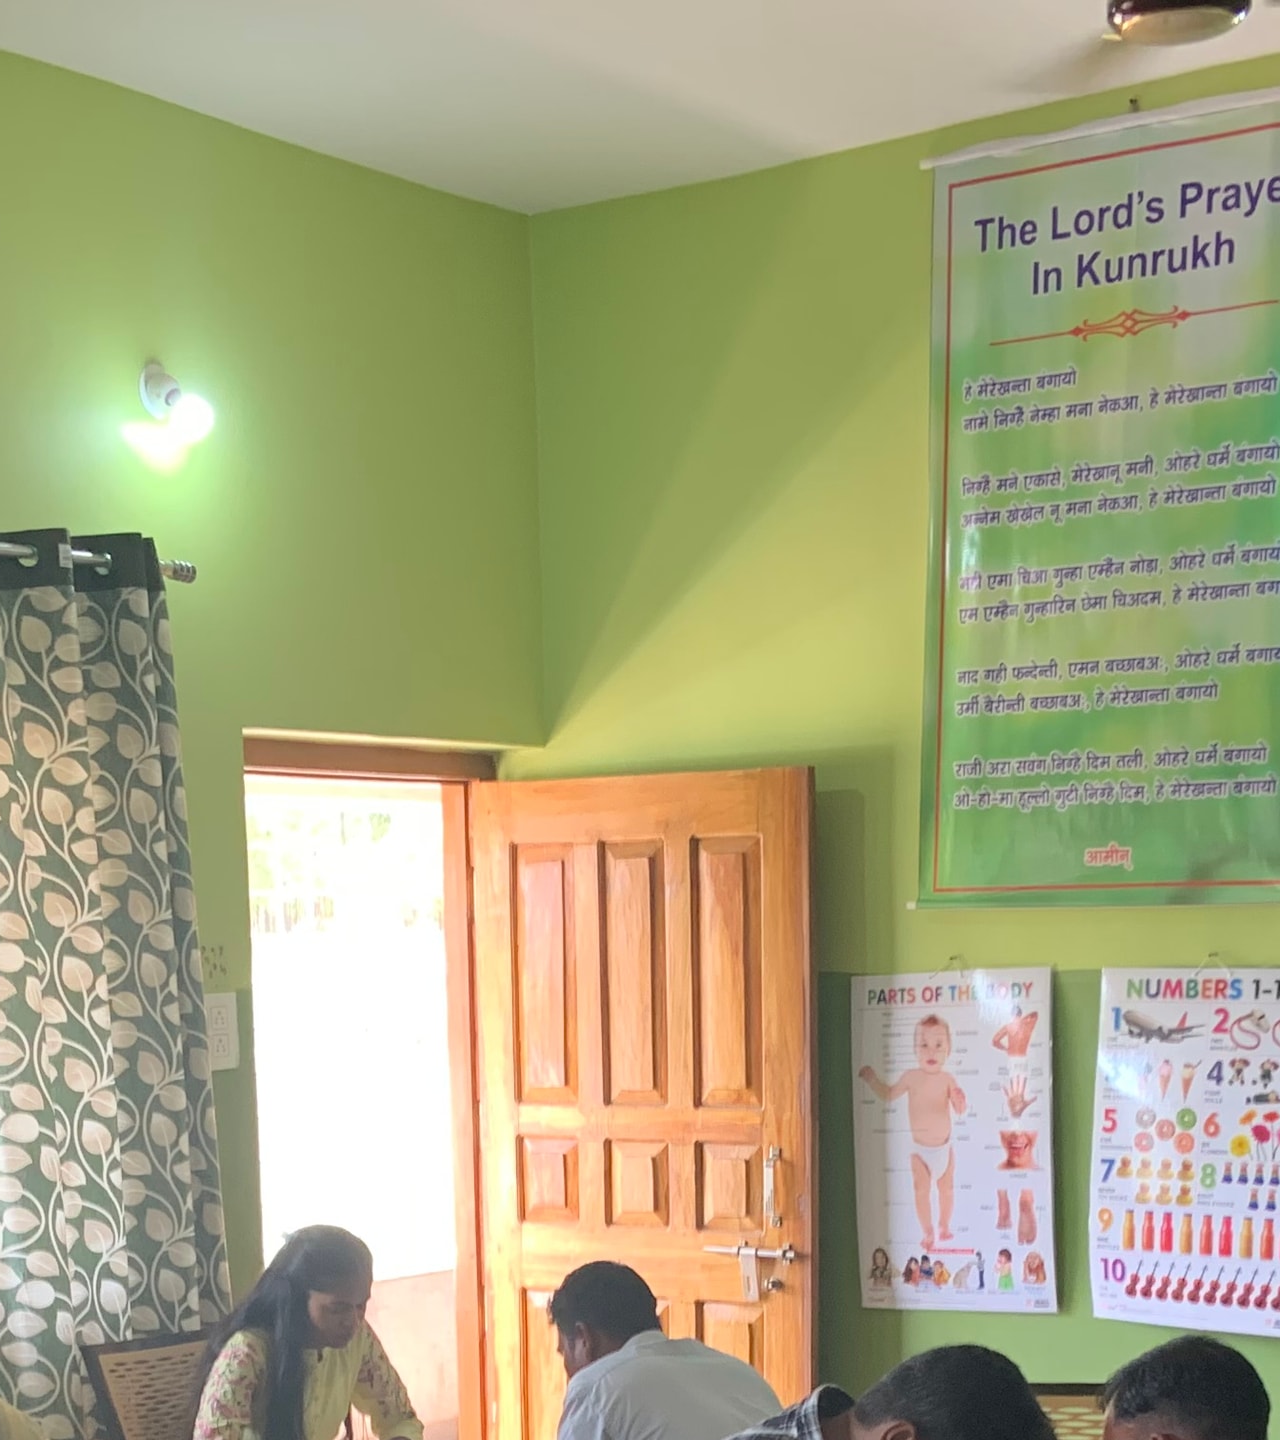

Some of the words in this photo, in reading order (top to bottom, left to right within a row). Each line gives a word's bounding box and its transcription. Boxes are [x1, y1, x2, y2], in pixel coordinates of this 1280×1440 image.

[974, 216, 1038, 254] The
[1051, 190, 1165, 241] Lord's
[1032, 261, 1062, 296] In
[1077, 231, 1236, 288] Kunrukh
[867, 987, 916, 1005] PARTS
[921, 985, 943, 1002] OF
[1126, 978, 1243, 1000] NUMBERS
[1111, 1007, 1121, 1032] 1
[1212, 1008, 1229, 1034] 2
[1207, 1061, 1223, 1086] 4
[1102, 1108, 1118, 1133] 5
[1203, 1112, 1220, 1138] 6
[1100, 1158, 1116, 1183] 7
[1200, 1163, 1216, 1189] 8
[1097, 1207, 1113, 1233] 9
[1100, 1257, 1126, 1283] 10
